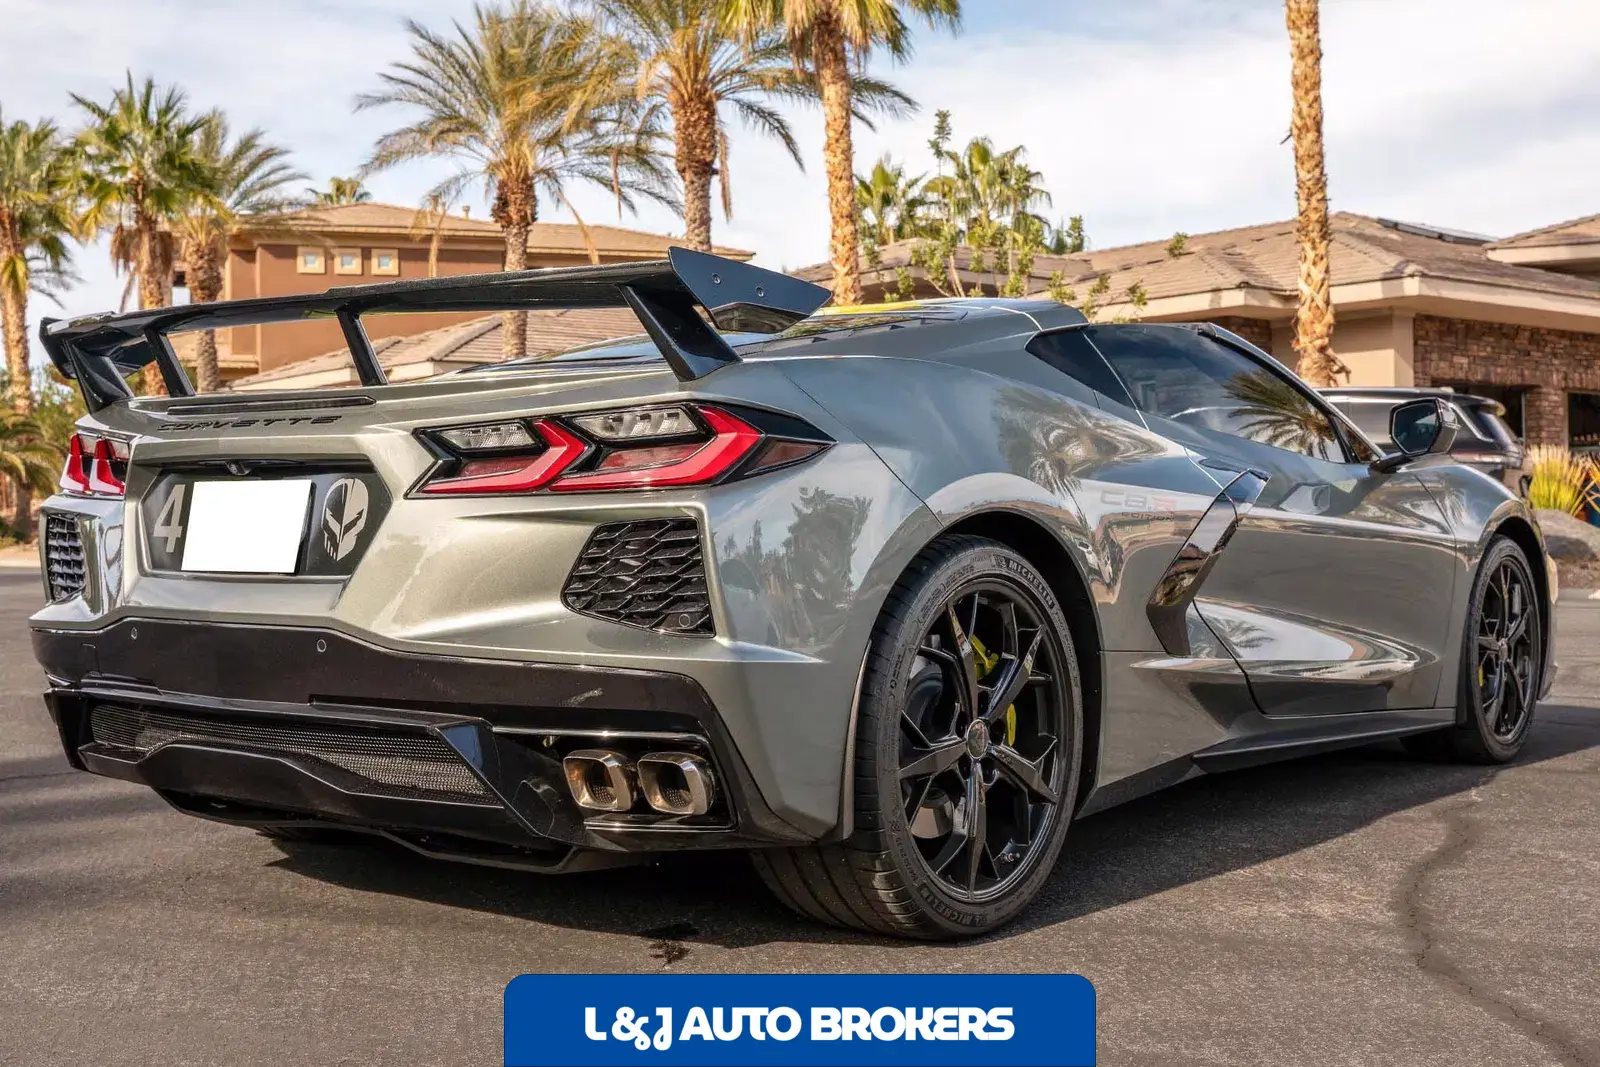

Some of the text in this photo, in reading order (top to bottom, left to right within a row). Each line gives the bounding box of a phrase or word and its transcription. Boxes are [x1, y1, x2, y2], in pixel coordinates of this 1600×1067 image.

[157, 415, 342, 431] CORVETTE
[153, 484, 186, 553] 4
[1008, 559, 1055, 608] MICHELIN
[920, 886, 973, 925] MICHELIN
